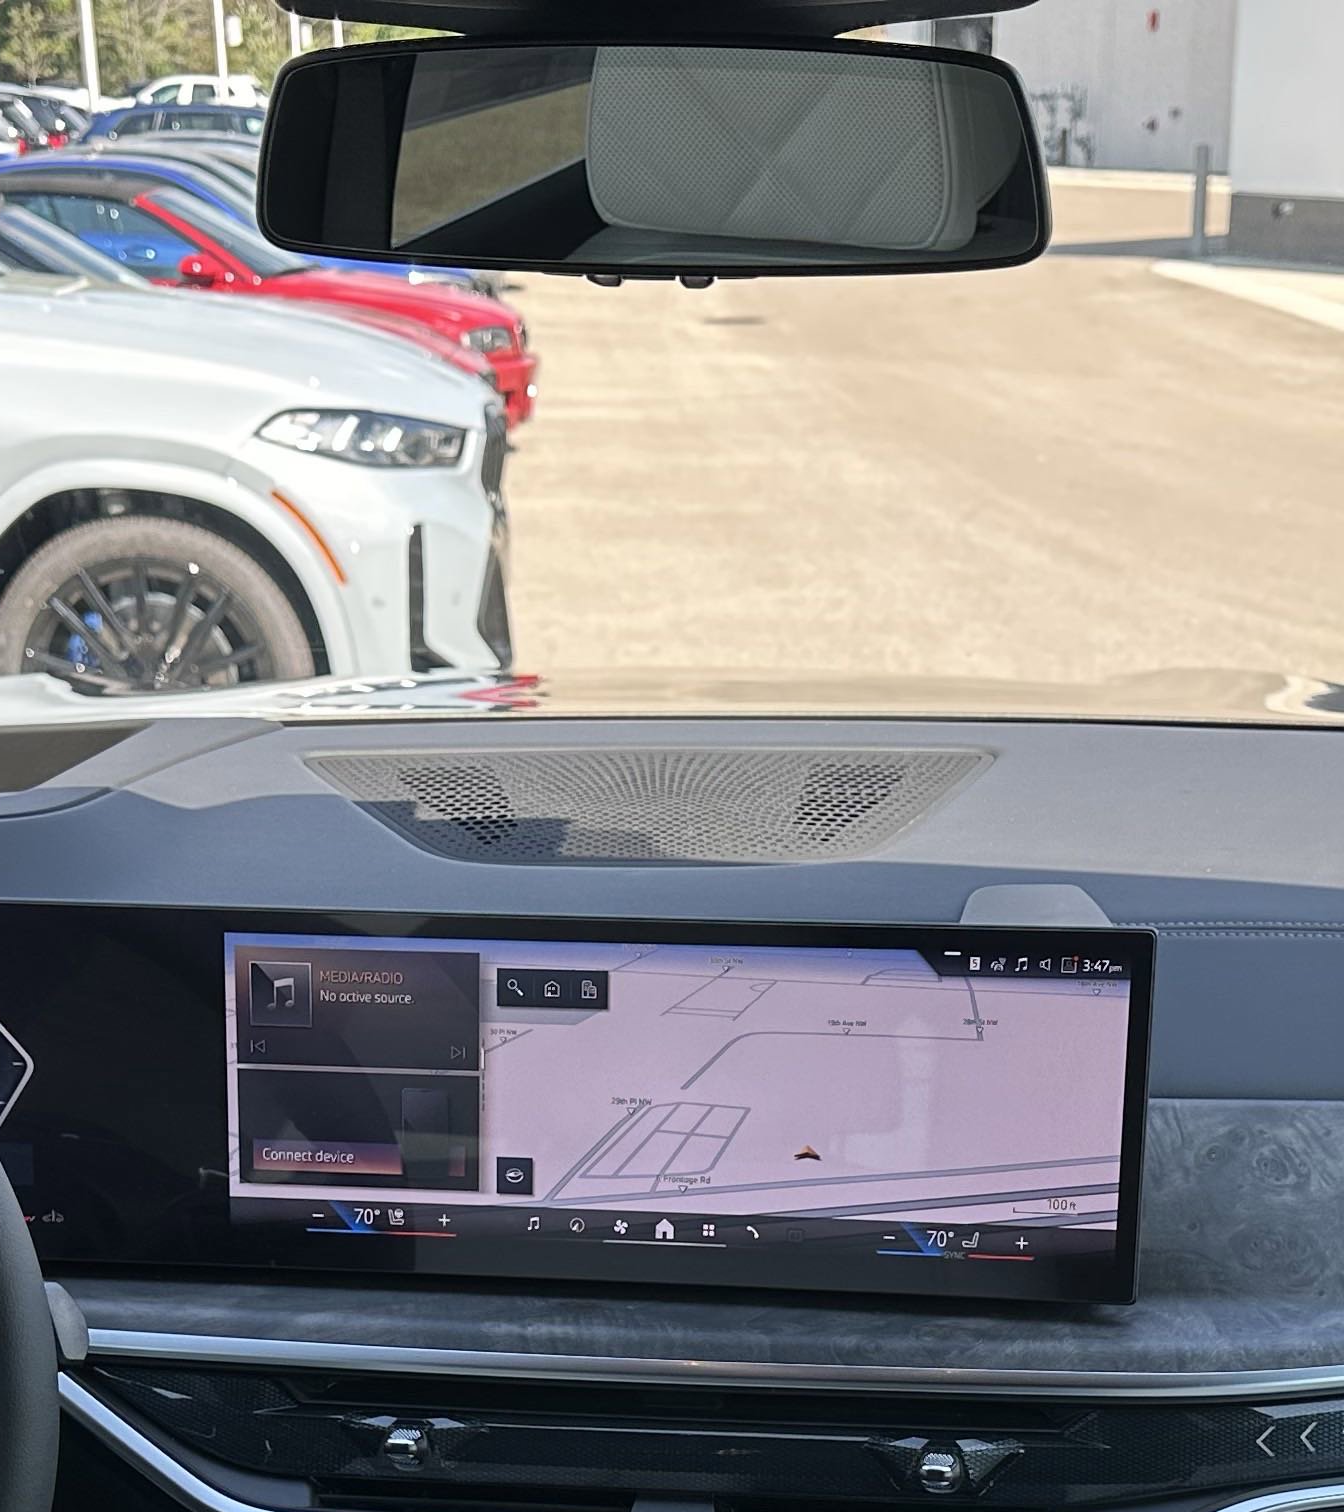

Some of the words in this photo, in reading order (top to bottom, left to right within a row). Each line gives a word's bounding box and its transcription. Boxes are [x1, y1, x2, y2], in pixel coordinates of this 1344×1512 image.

[319, 970, 403, 985] MEDIA/RADIO
[319, 989, 337, 1002] No
[339, 990, 372, 1003] active
[374, 993, 415, 1005] source.
[262, 1147, 313, 1162] Connect
[315, 1150, 355, 1164] device
[663, 1176, 698, 1185] Frontage
[699, 1176, 711, 1184] Rd
[1047, 1198, 1068, 1211] 100
[353, 1208, 381, 1225] 70°
[926, 1230, 955, 1247] 70°
